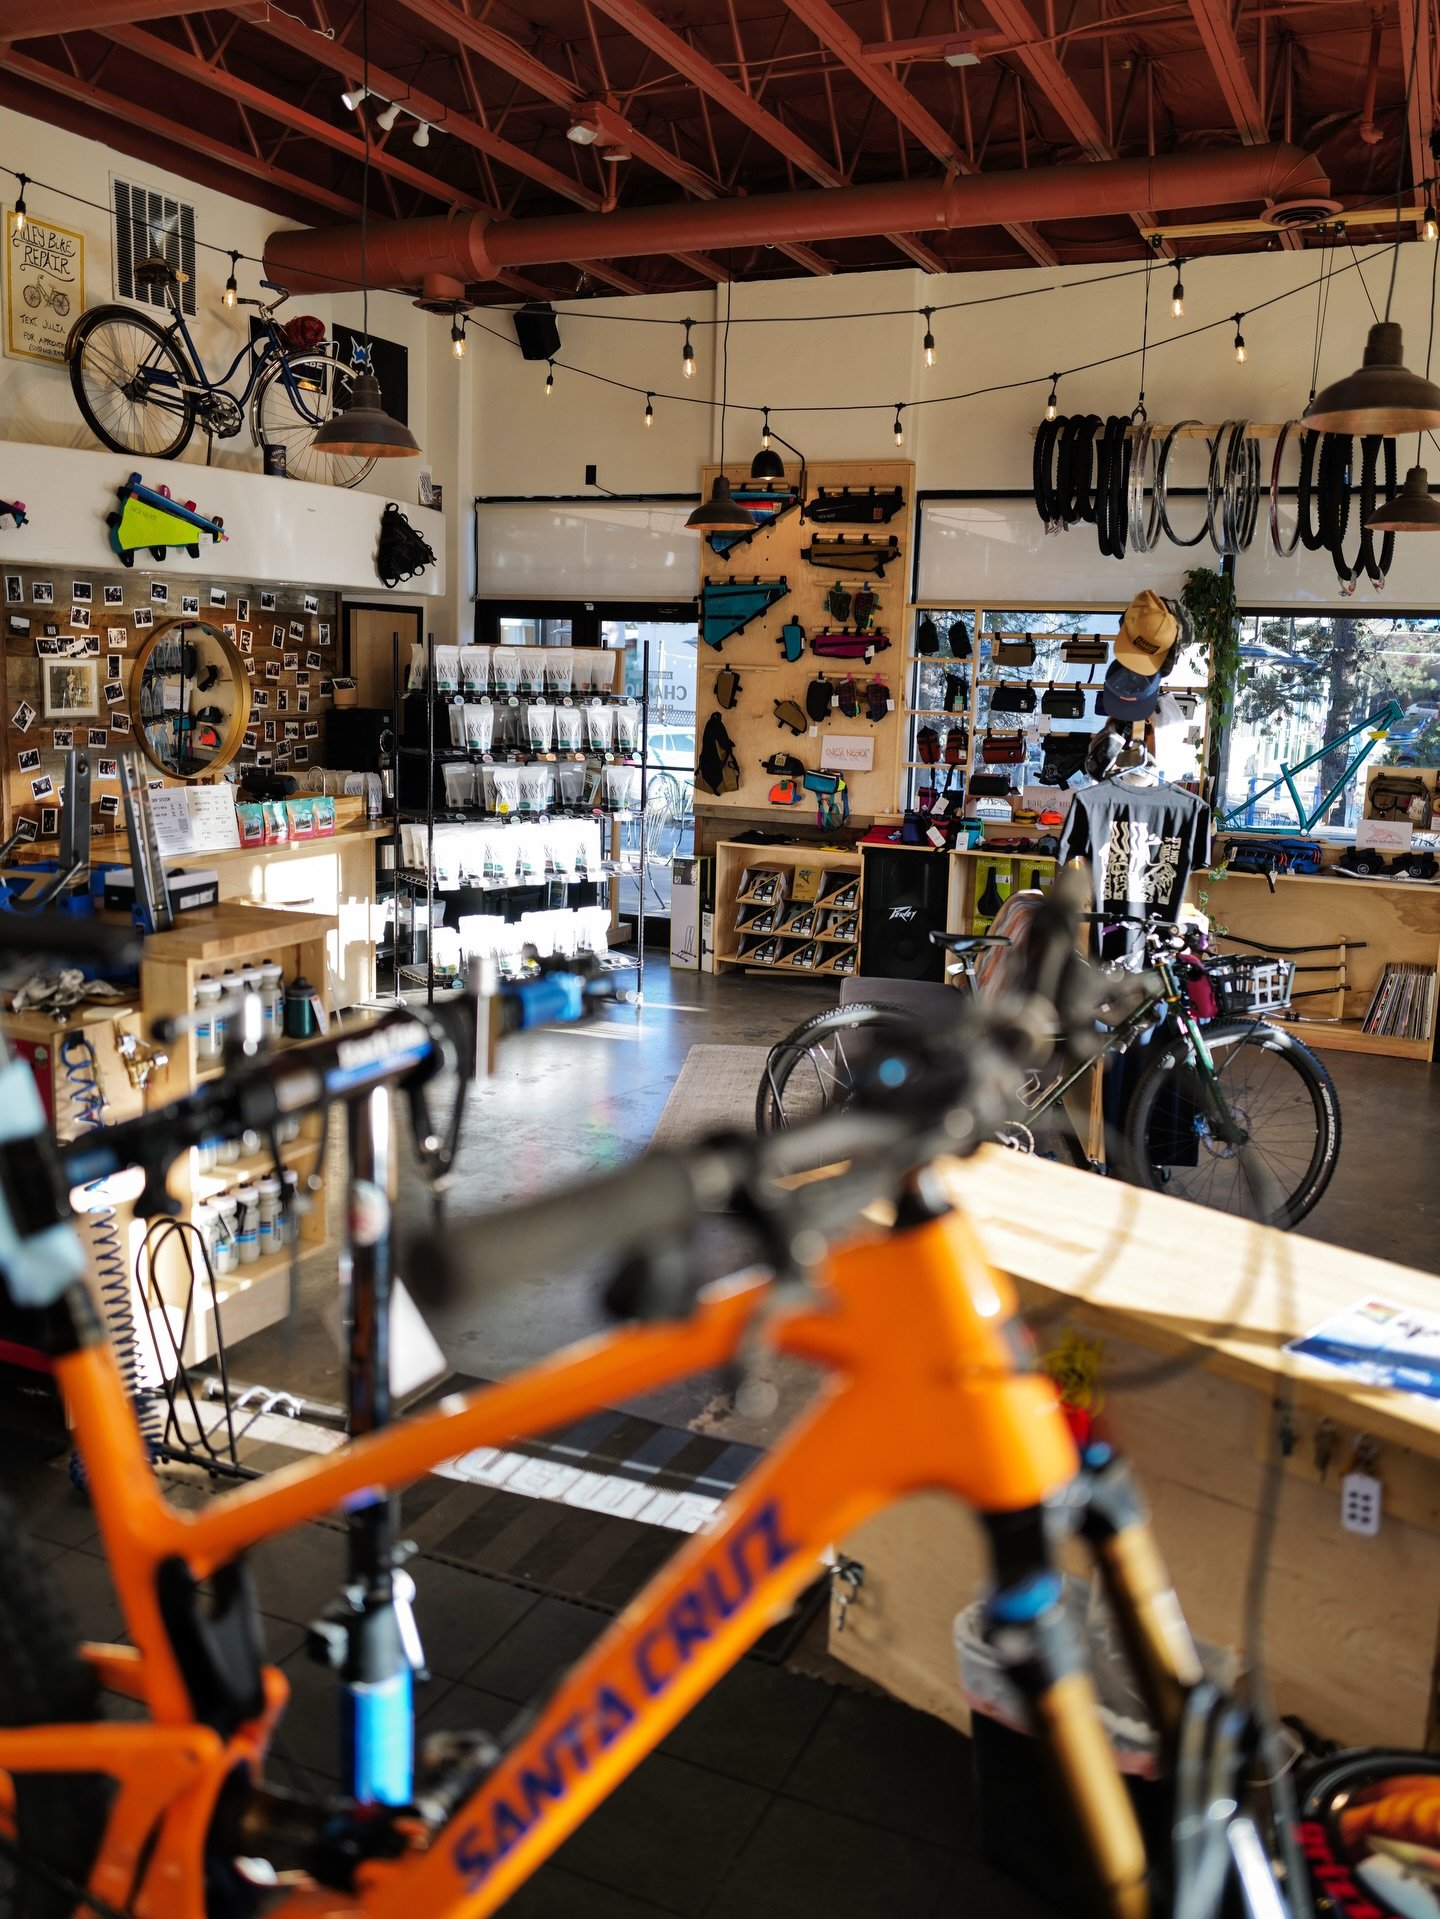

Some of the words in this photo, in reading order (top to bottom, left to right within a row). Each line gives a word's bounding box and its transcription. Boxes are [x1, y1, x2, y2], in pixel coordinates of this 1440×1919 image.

[24, 245, 71, 275] REPAIR
[20, 314, 37, 326] TEXT
[23, 331, 36, 342] FOR
[977, 860, 1011, 868] Mountain
[1170, 850, 1180, 865] NOT
[1324, 1115, 1336, 1162] MEZCAL
[452, 1685, 638, 1895] SANTA
[633, 1496, 804, 1697] CRUZ
